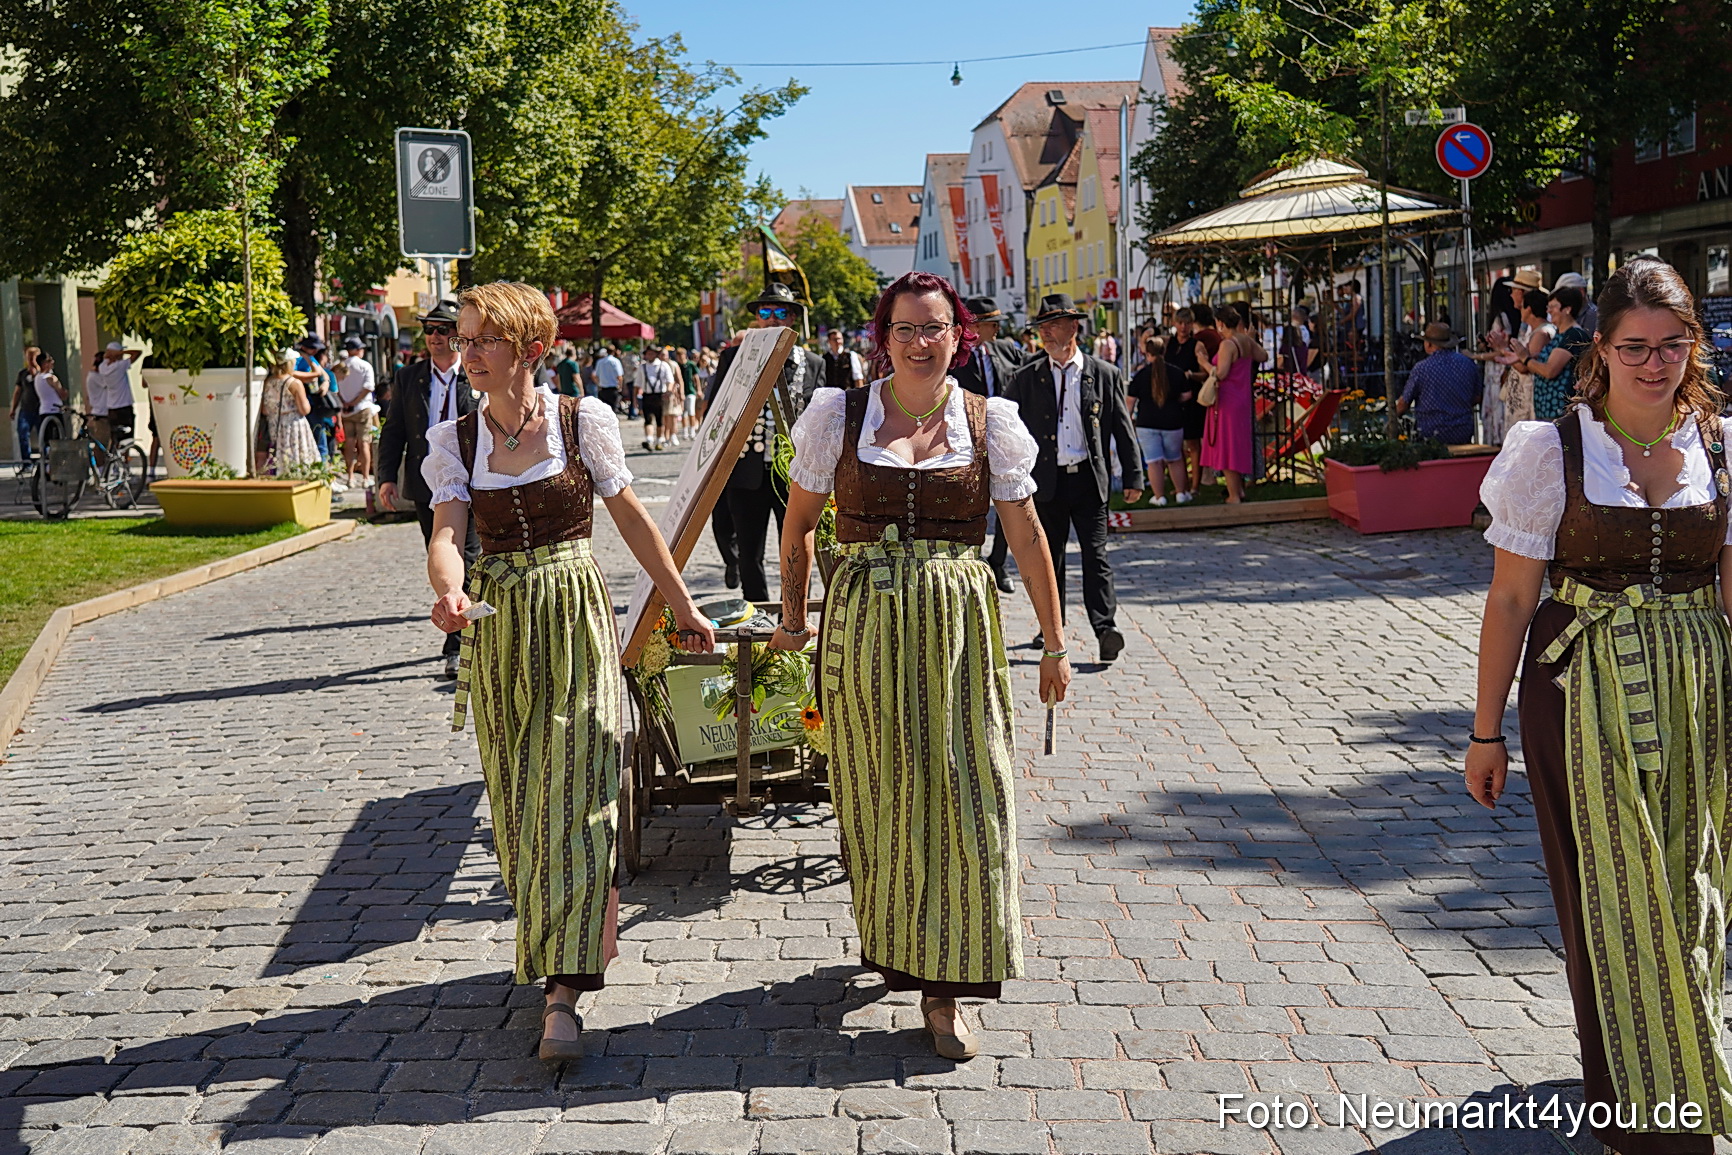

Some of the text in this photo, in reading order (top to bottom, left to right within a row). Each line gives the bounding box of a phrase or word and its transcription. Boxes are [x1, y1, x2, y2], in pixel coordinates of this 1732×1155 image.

[423, 185, 448, 196] ZONE
[699, 712, 791, 745] NEUMRKTER
[713, 732, 783, 753] MINERRUNNEN
